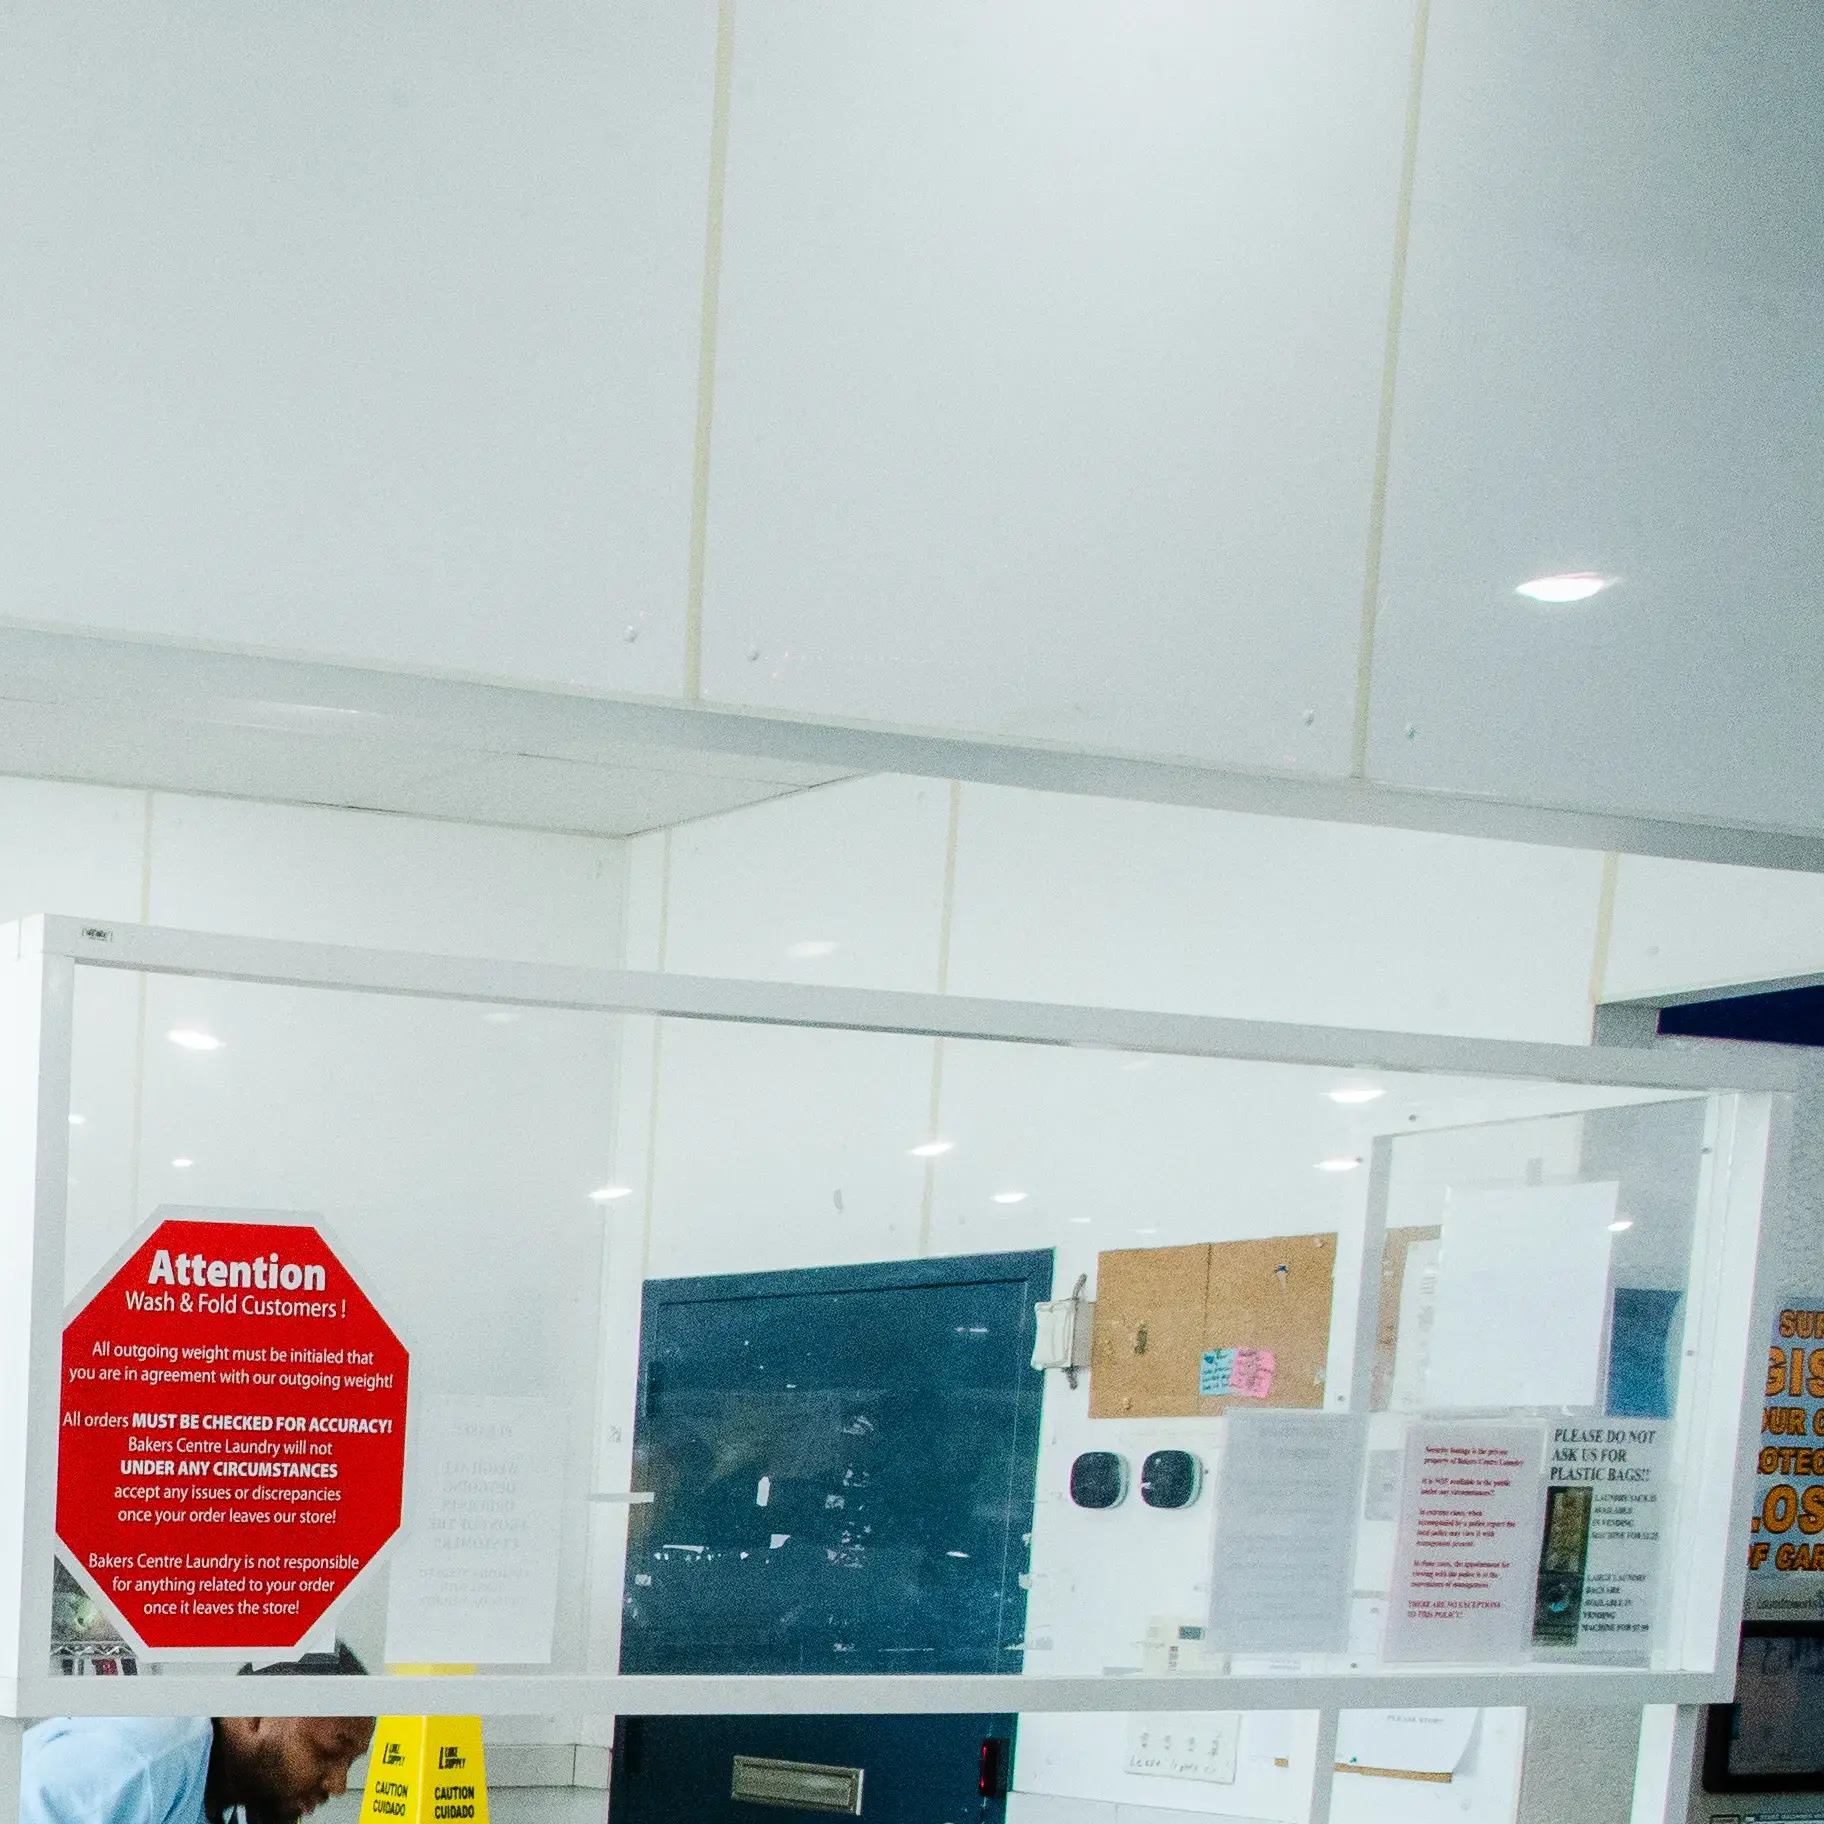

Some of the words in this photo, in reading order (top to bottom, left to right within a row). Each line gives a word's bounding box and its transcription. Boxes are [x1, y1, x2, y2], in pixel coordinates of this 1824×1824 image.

[148, 1250, 325, 1291] Attention
[125, 1291, 175, 1312] Wash
[180, 1292, 193, 1313] &
[198, 1295, 236, 1314] Fold
[242, 1296, 336, 1317] Customers
[92, 1342, 110, 1357] All
[114, 1344, 178, 1362] outgoing
[181, 1345, 229, 1362] weight
[233, 1348, 266, 1362] must
[270, 1347, 287, 1362] be
[290, 1349, 344, 1364] initialed
[348, 1350, 373, 1365] that
[1554, 1429, 1603, 1444] PLEASE
[1606, 1429, 1626, 1444] DO
[1629, 1430, 1656, 1444] NOT
[1552, 1449, 1580, 1462] ASK
[1582, 1449, 1599, 1462] US
[1601, 1449, 1627, 1463] FOR
[121, 1461, 174, 1476] UNDER
[178, 1461, 209, 1477] ANY
[214, 1462, 338, 1479] CIRCUMSTANCES
[1550, 1467, 1603, 1481] PLASTIC
[1607, 1468, 1651, 1482] BAGS!!
[1747, 1542, 1770, 1570] F
[143, 1602, 177, 1615] once
[181, 1601, 190, 1615] it
[193, 1601, 234, 1615] leaves
[238, 1601, 259, 1615] the
[263, 1601, 299, 1615] store!
[375, 1781, 408, 1799] CAUTION
[434, 1786, 474, 1801] CAUTION
[373, 1800, 405, 1817] CUIDADO
[434, 1804, 474, 1820] CUIDADO
